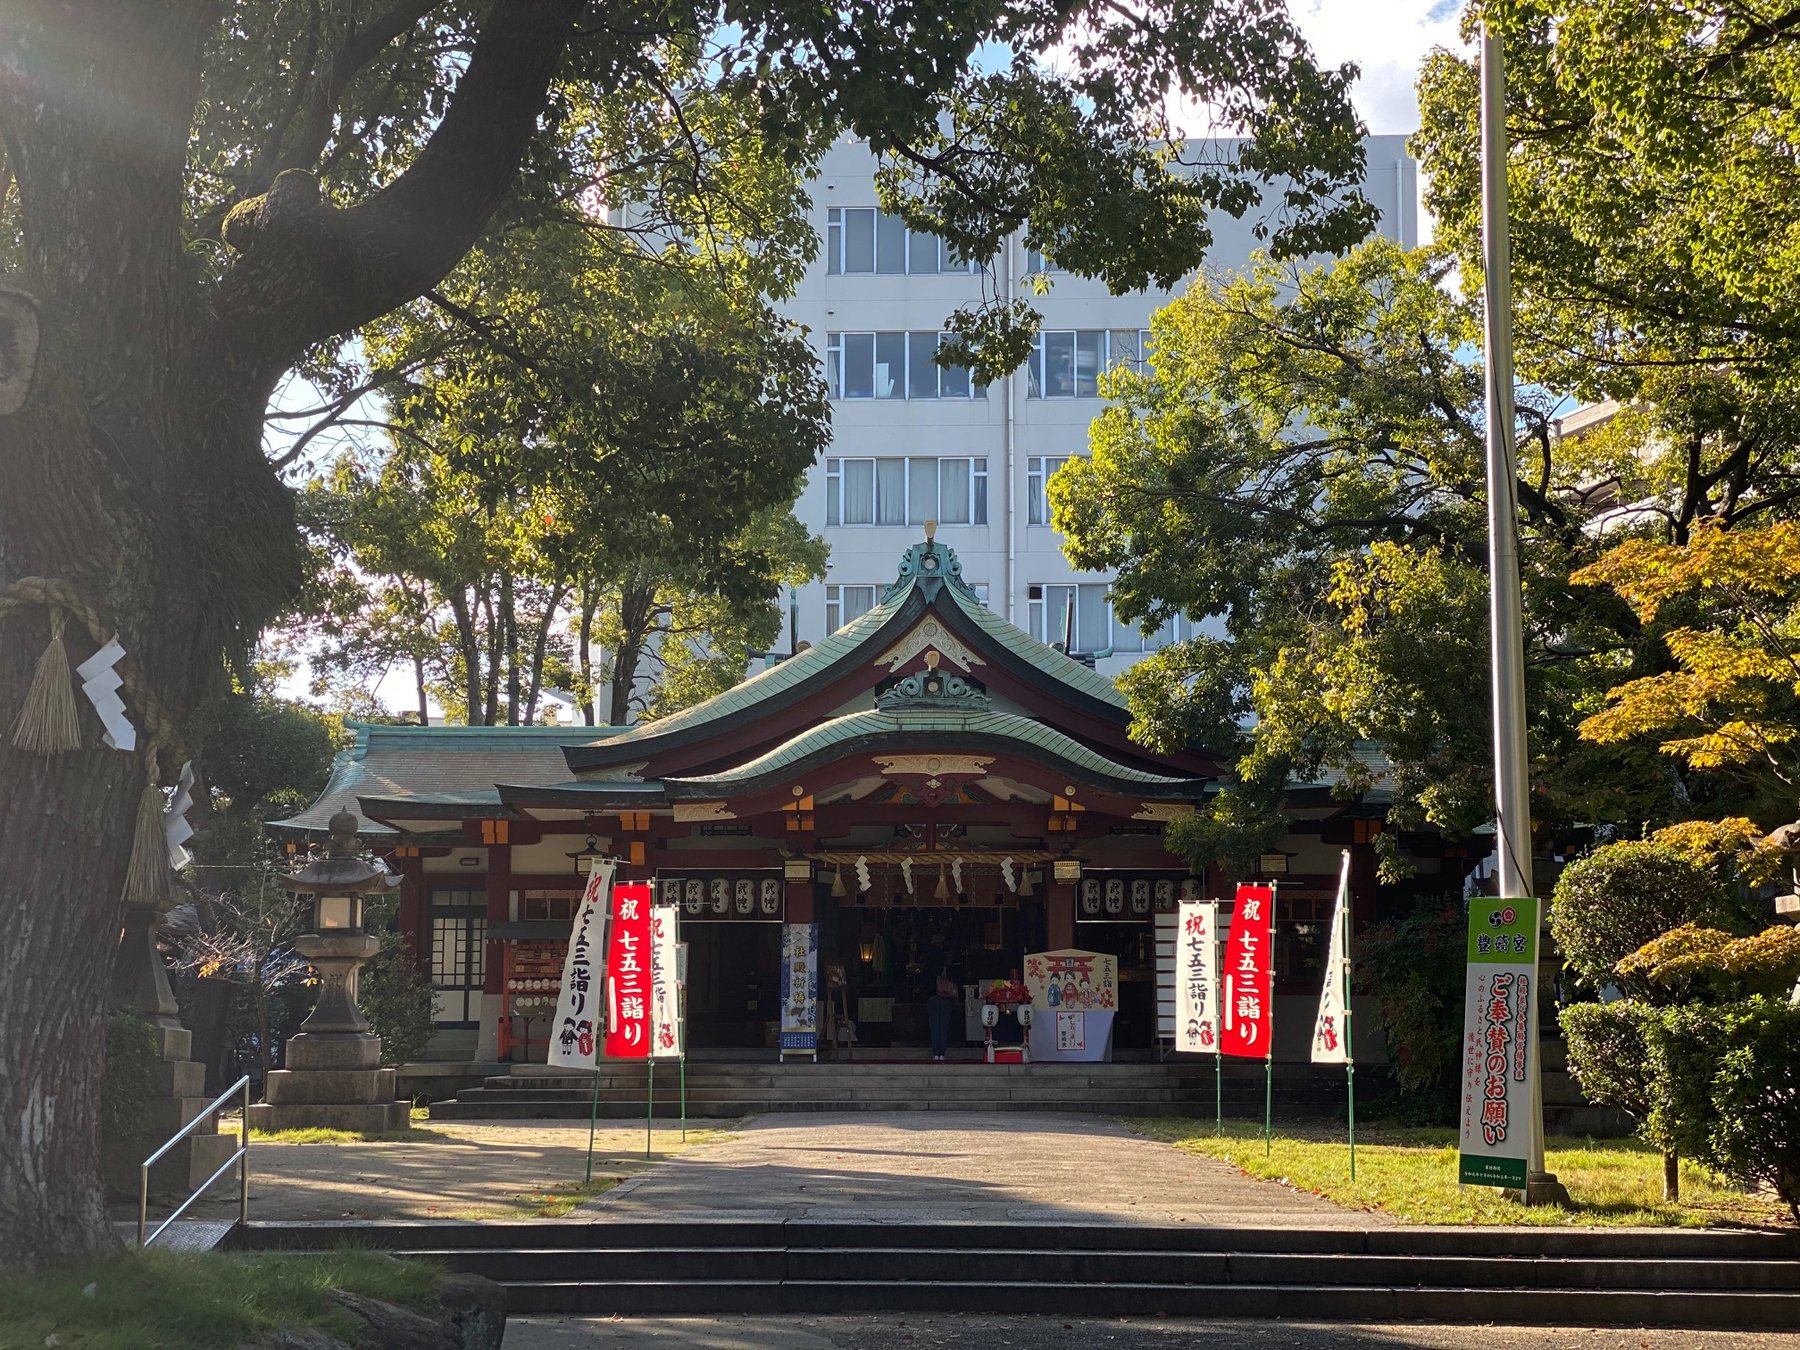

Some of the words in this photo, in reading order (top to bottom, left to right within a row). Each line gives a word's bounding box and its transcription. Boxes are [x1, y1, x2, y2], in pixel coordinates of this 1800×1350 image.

[619, 897, 640, 921] 祝
[1241, 898, 1261, 921] 祝
[617, 930, 645, 1047] 七五三詣り
[1236, 930, 1261, 1047] 七五三詣り
[1474, 975, 1486, 1086] 心のふるさと氏神様を
[1465, 1032, 1475, 1138] 後世に守り伝えよう
[1482, 973, 1512, 1145] ご奉賛のお願い
